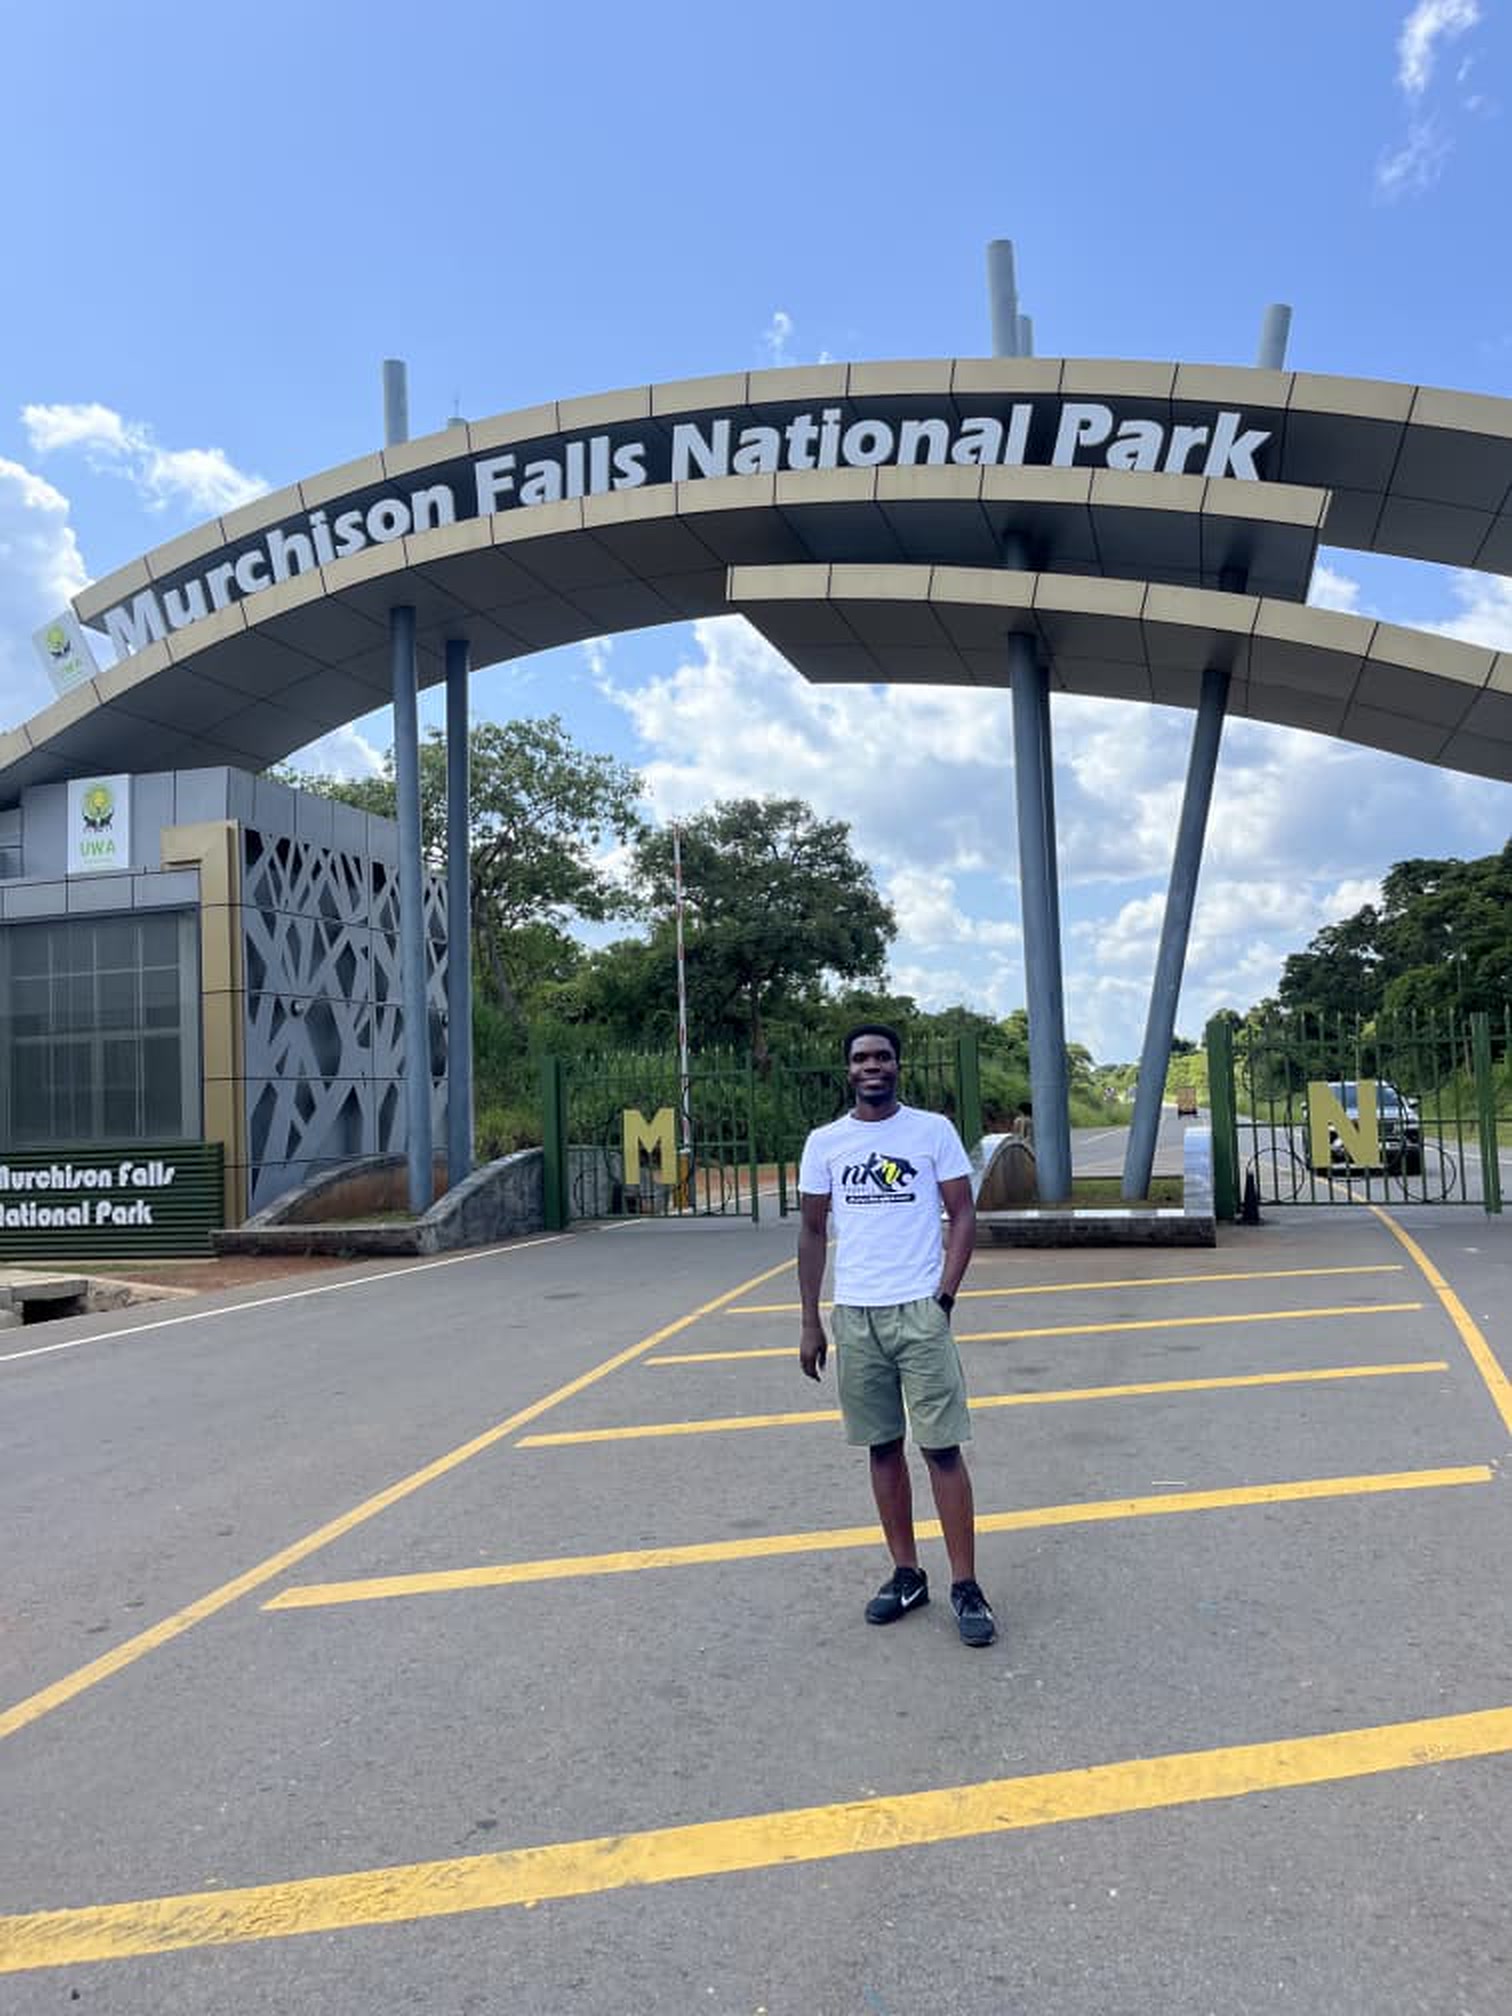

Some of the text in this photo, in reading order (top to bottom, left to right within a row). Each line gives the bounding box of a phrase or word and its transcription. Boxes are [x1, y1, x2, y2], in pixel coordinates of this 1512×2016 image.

[102, 402, 1271, 660] Murchison Falls National Park
[80, 839, 115, 857] UWA
[623, 1106, 678, 1185] M
[1308, 1080, 1380, 1168] N
[119, 1161, 176, 1187] Falls
[96, 1200, 153, 1225] Park
